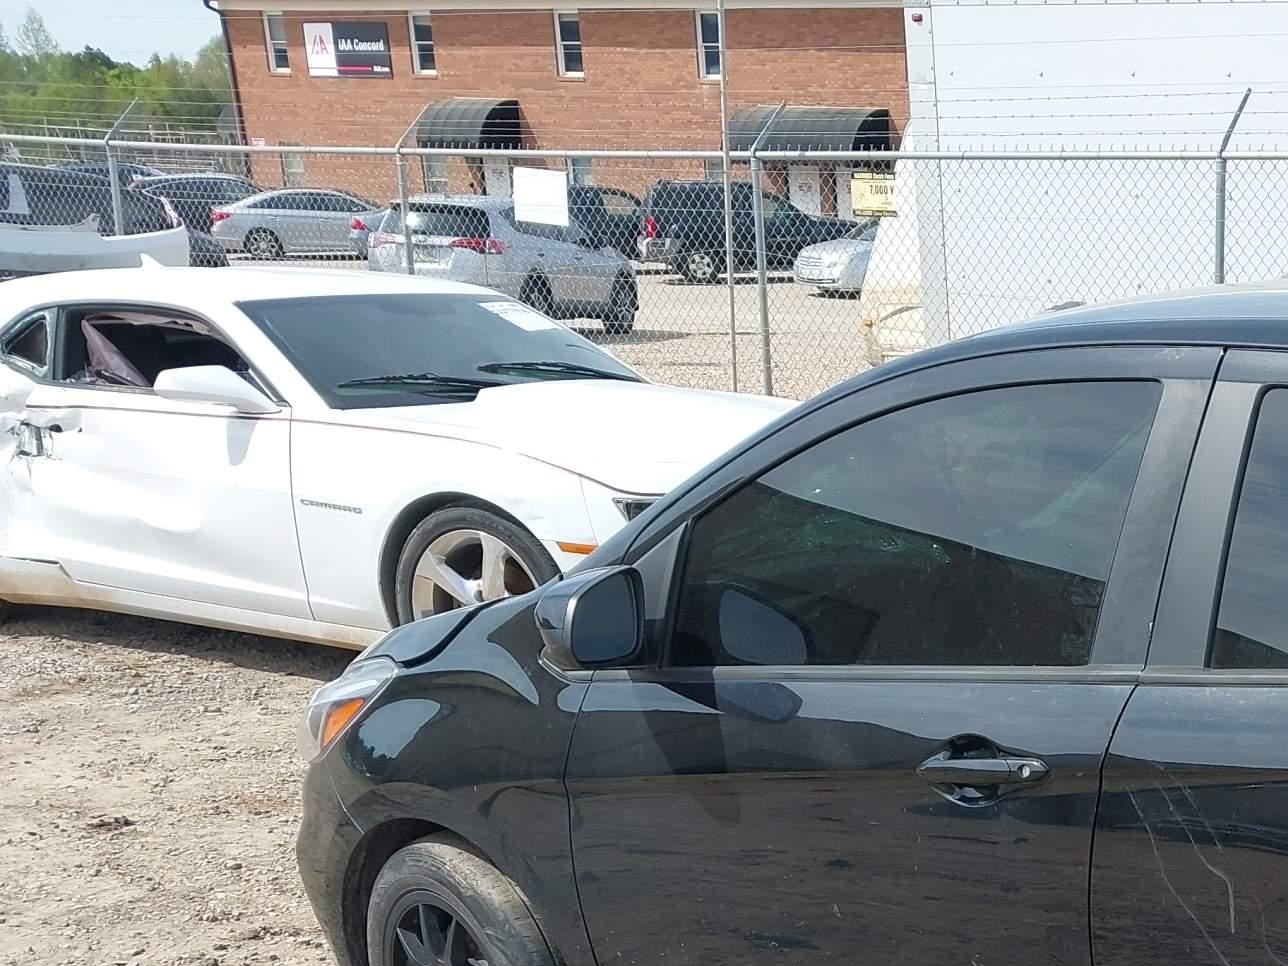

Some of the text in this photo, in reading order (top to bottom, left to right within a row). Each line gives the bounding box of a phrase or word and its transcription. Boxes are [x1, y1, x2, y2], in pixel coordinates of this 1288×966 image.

[338, 38, 385, 51] IAA Concord
[869, 184, 894, 196] 7,000 V
[300, 499, 363, 515] CAMARO
